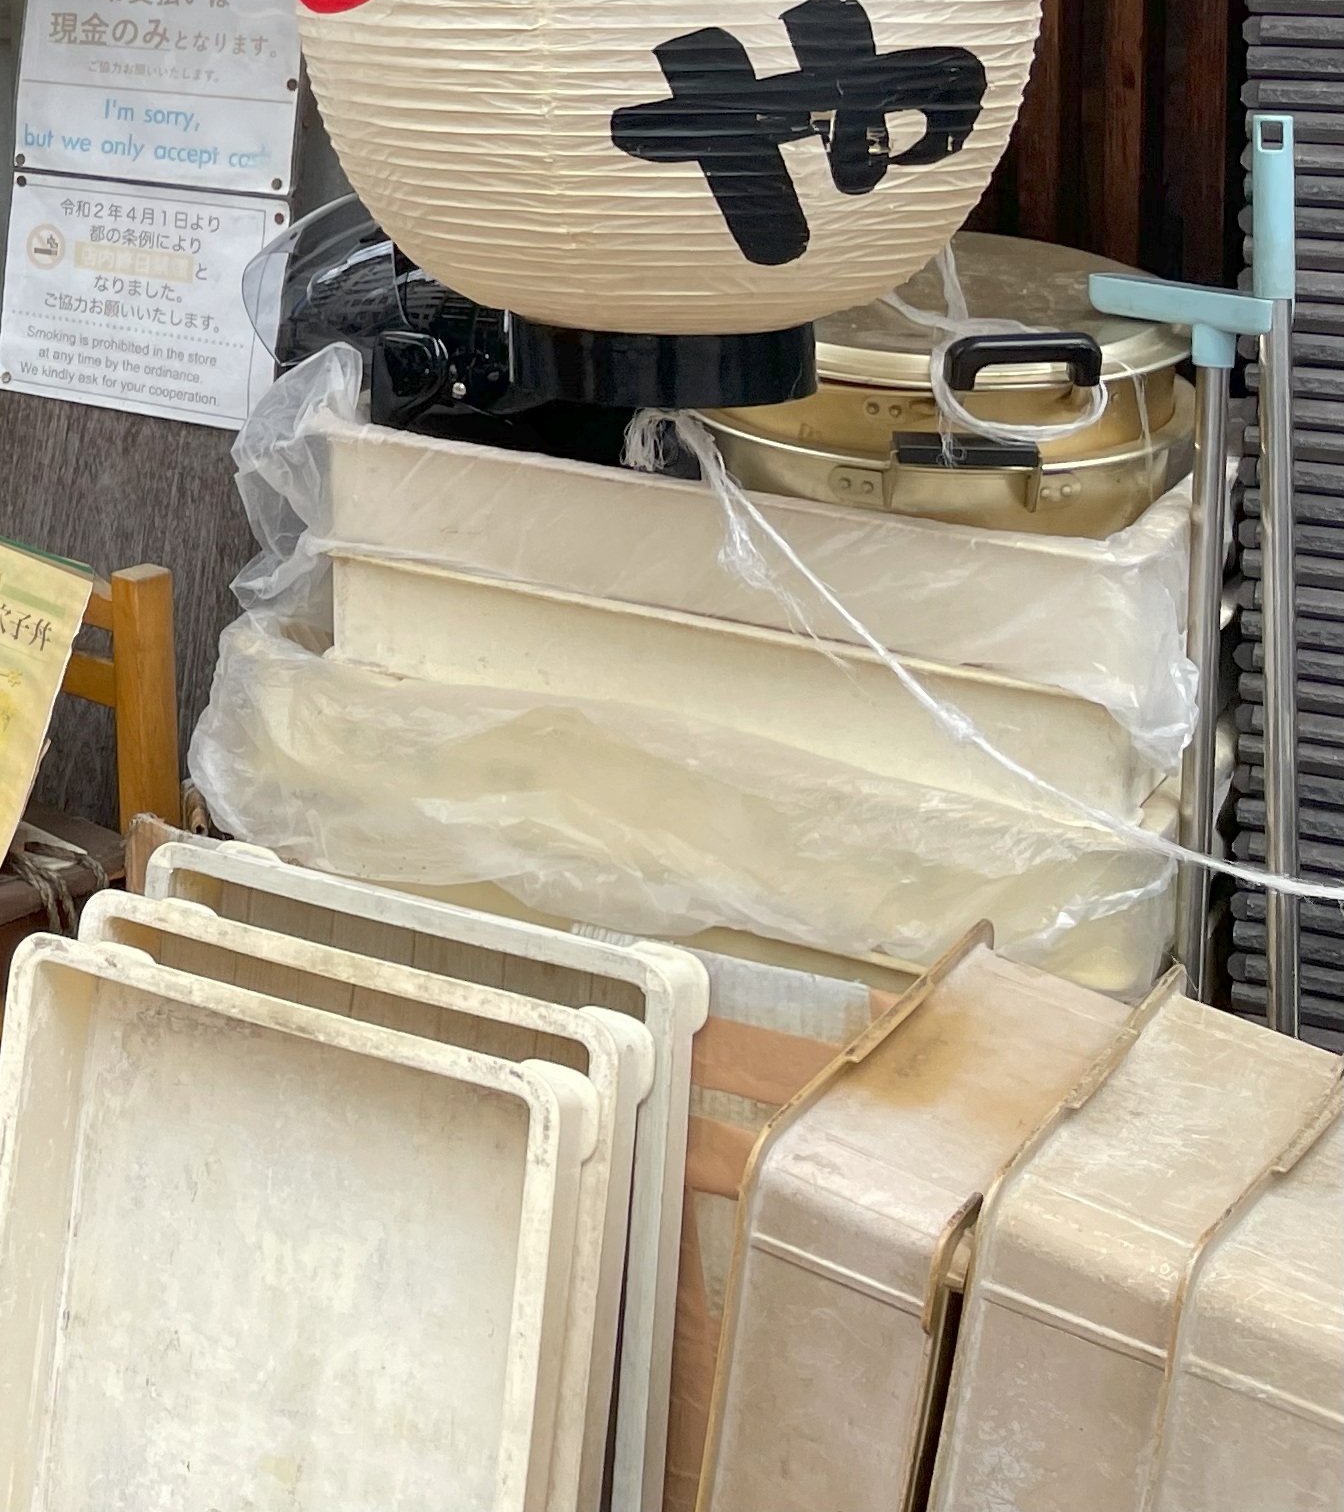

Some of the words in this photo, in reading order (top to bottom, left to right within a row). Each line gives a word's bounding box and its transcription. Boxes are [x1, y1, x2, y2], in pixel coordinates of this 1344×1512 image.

[49, 12, 278, 58] 現金のみとなります。
[88, 60, 221, 83] ご協力お願いいたします。
[103, 98, 135, 122] I'm
[143, 105, 200, 131] sorry,
[24, 123, 54, 148] but
[62, 135, 92, 152] we
[101, 134, 145, 162] only
[154, 145, 219, 169] accept
[61, 198, 221, 233] 令和2年4月1日より
[89, 225, 202, 254] 都の条例により
[94, 275, 183, 303] なりました。
[44, 292, 220, 334] ご協力お願いいたします。
[27, 325, 76, 347] Smoking
[79, 335, 89, 346] is
[91, 336, 150, 356] prohibited
[152, 345, 163, 358] in
[165, 347, 185, 361] the
[187, 351, 217, 367] store
[20, 361, 39, 374] We
[41, 364, 75, 383] kindly
[78, 370, 99, 385] ask
[102, 374, 117, 387] for
[120, 379, 146, 396] your
[148, 383, 220, 407] cooperation.
[38, 348, 50, 359] at
[52, 351, 74, 365] any
[77, 352, 102, 367] time
[104, 356, 119, 372] by
[122, 360, 141, 373] the
[143, 363, 202, 384] ordinance.
